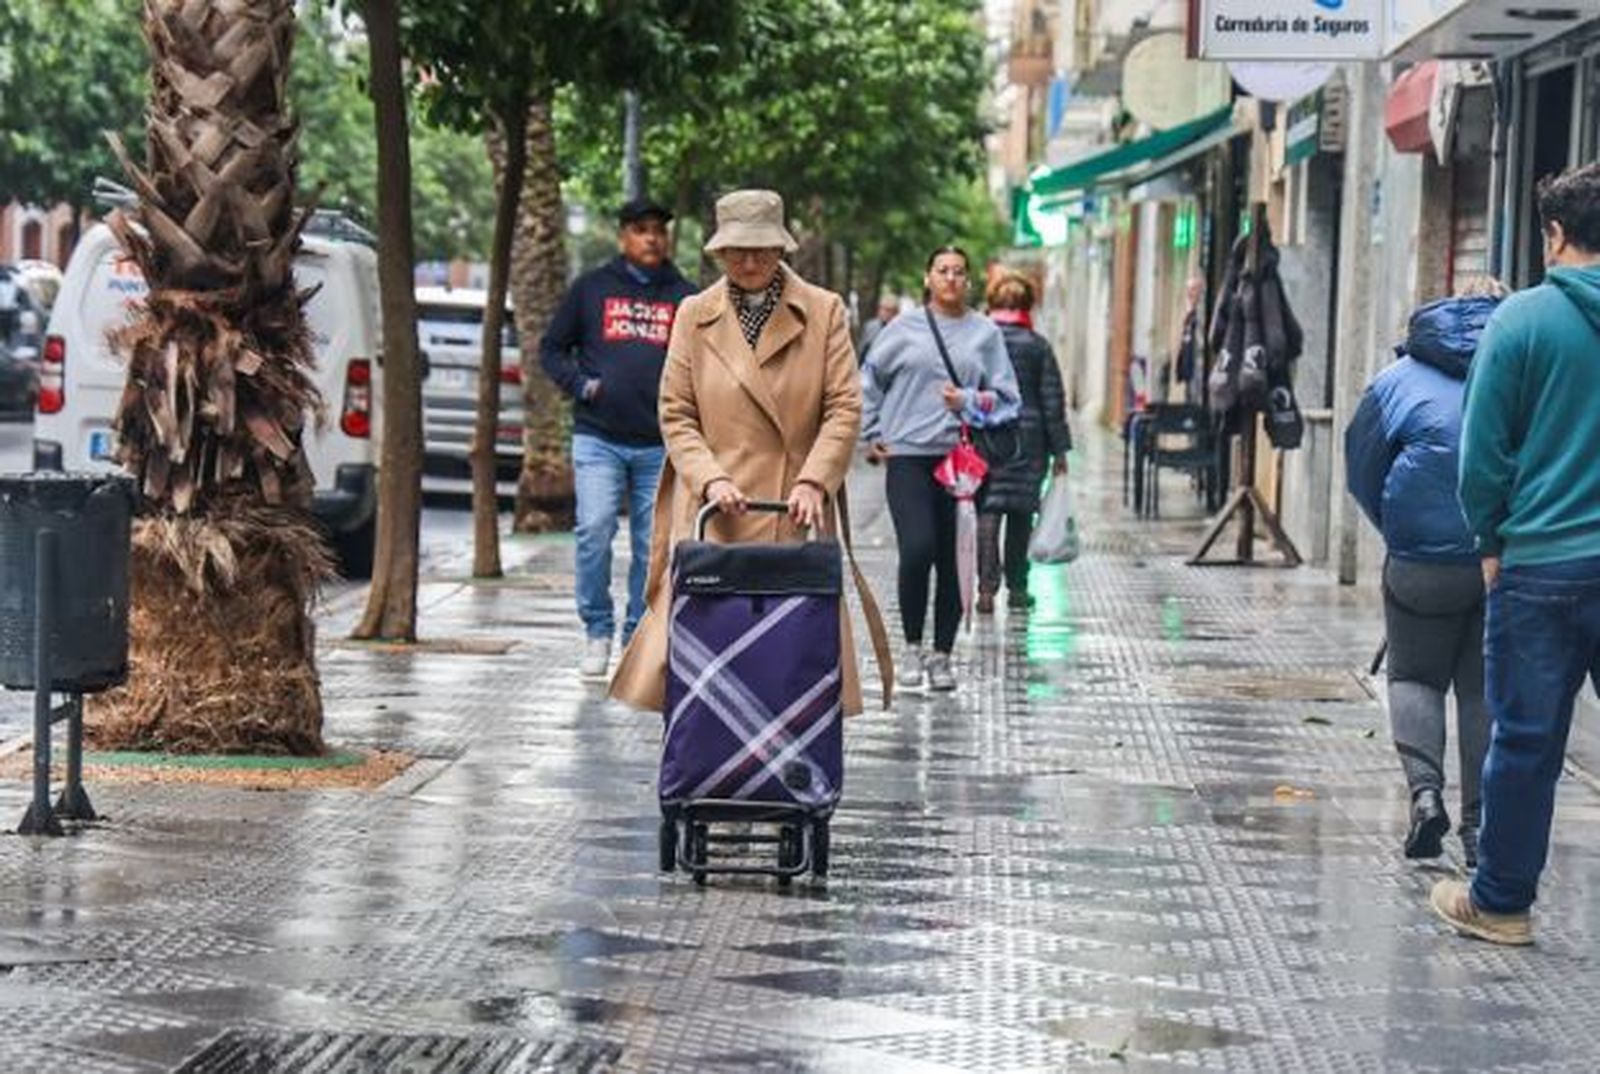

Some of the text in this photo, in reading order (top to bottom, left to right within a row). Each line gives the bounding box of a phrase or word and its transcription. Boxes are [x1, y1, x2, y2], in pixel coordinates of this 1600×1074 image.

[1215, 14, 1369, 37] Correduria de Seguros
